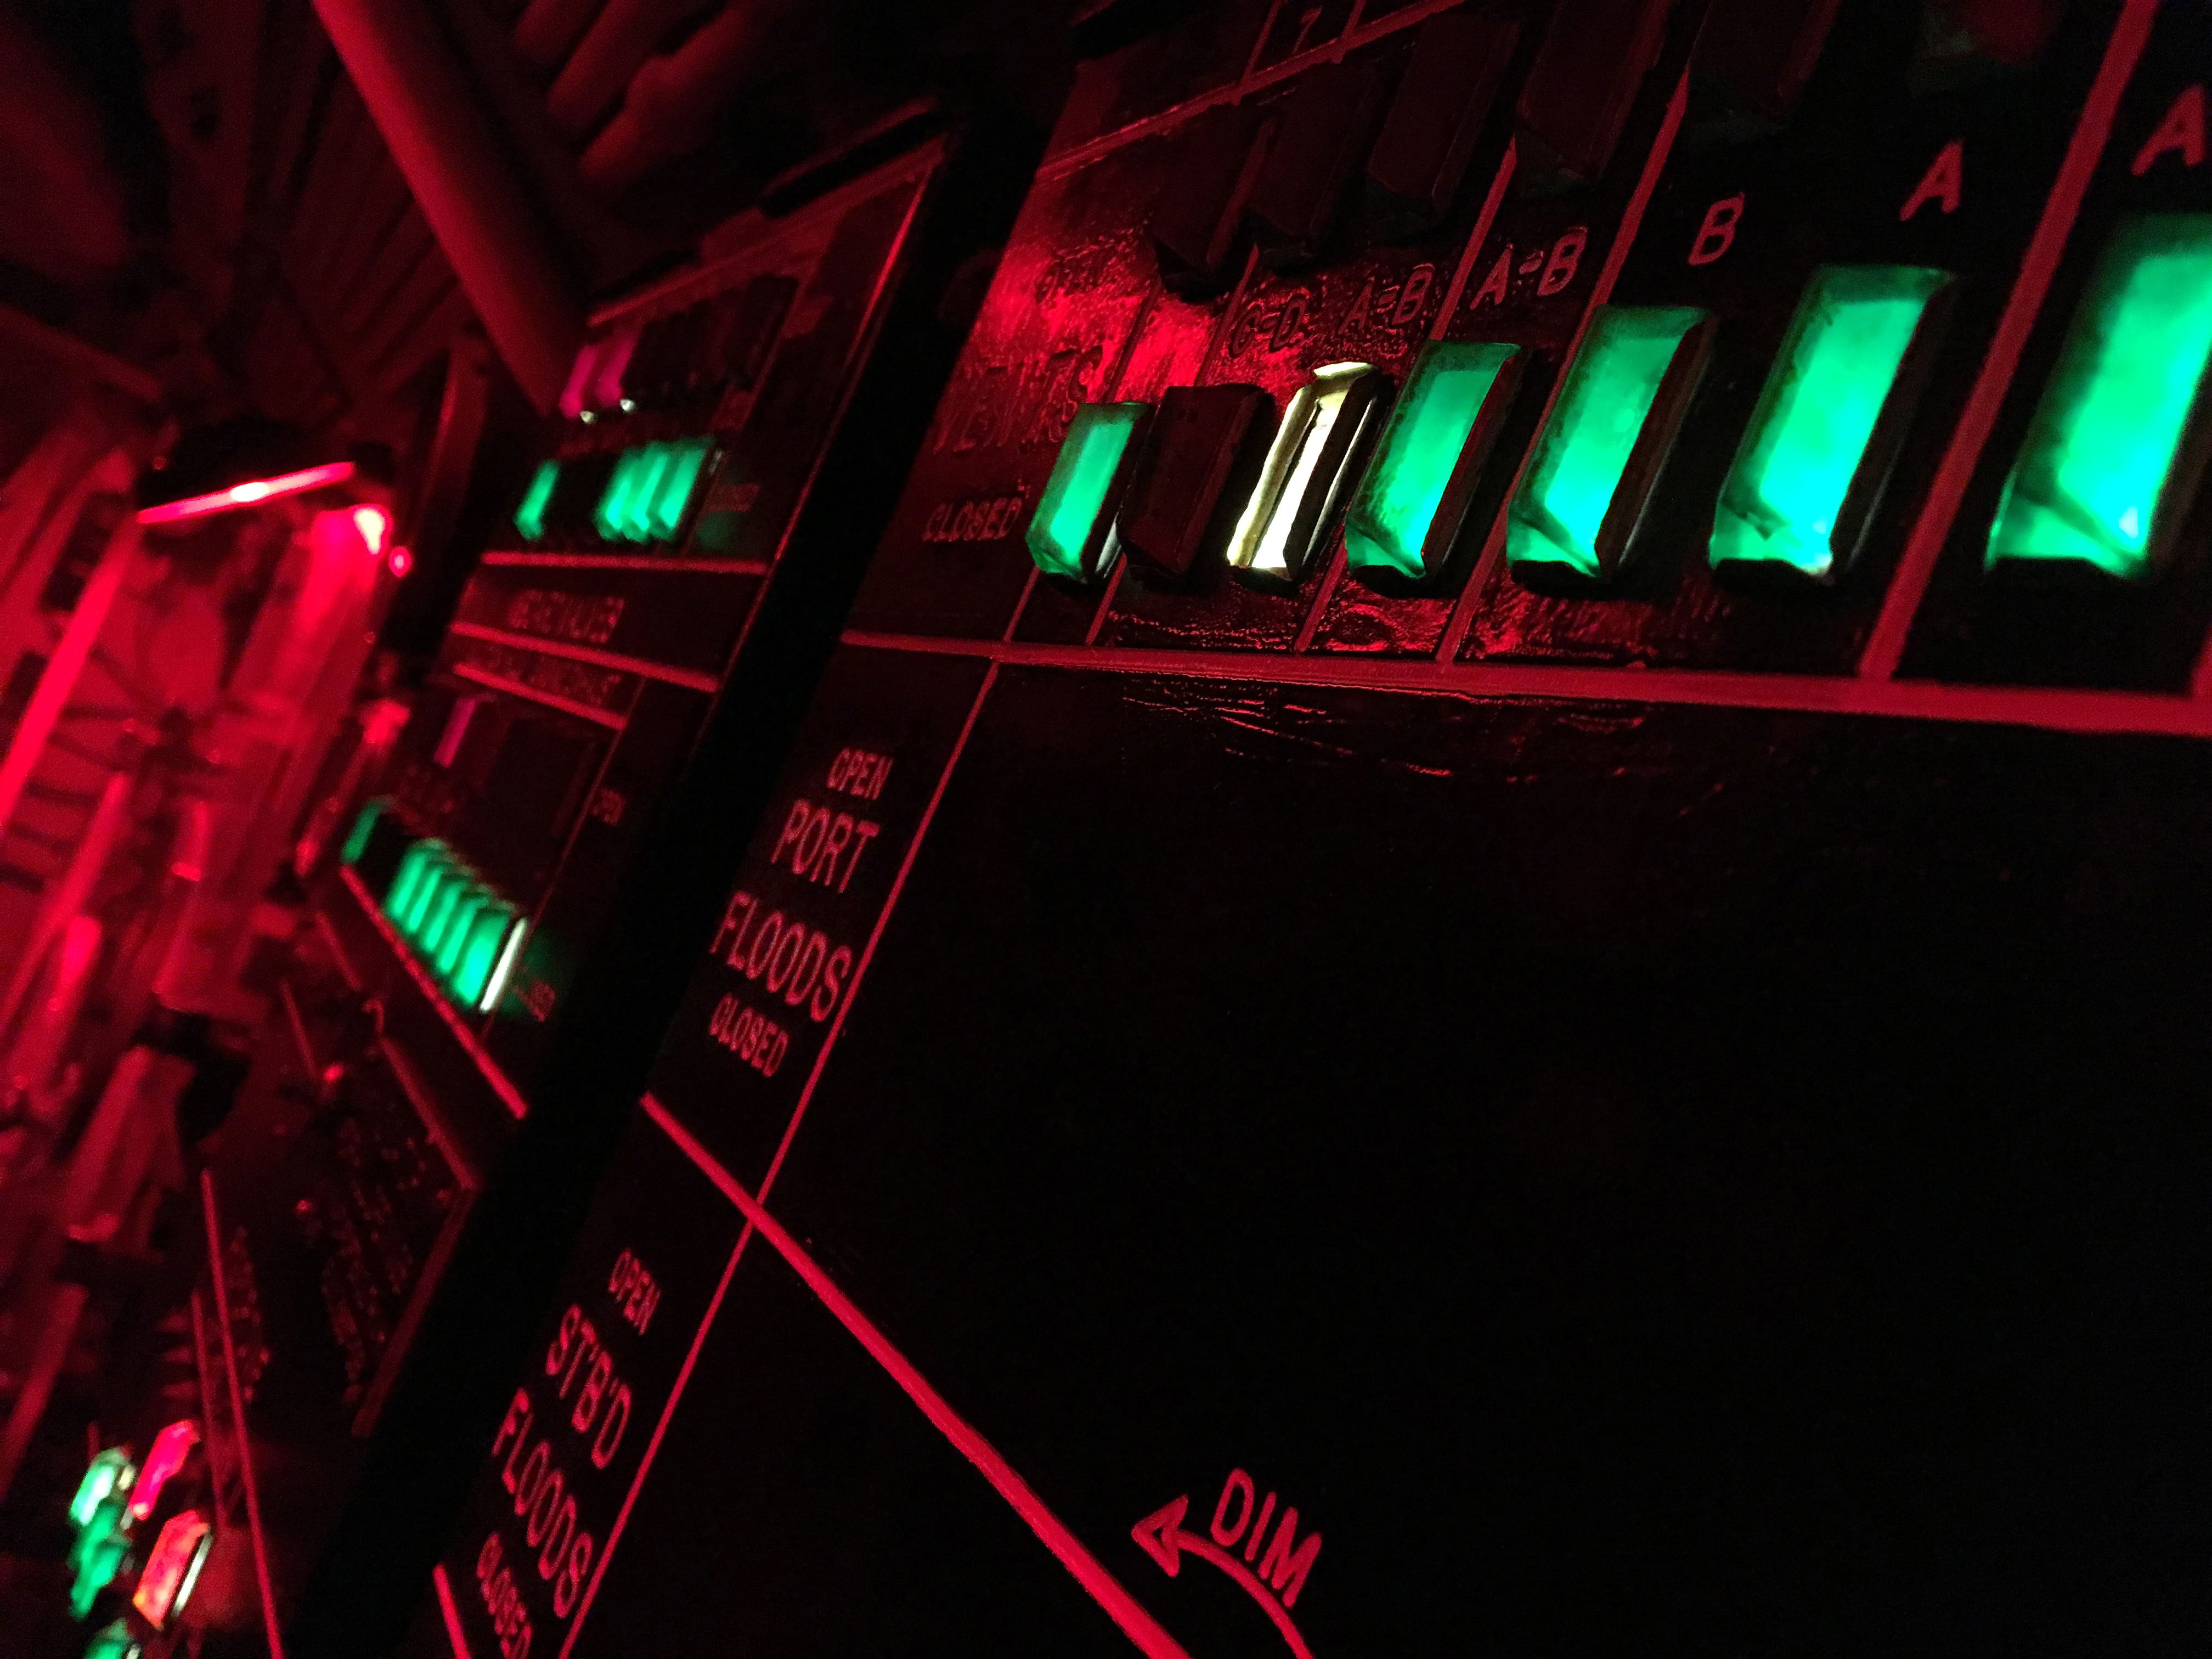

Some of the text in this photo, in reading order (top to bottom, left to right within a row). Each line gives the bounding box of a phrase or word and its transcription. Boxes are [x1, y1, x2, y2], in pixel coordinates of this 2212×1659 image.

[2130, 81, 2206, 178] A
[1897, 138, 1965, 221] A
[1686, 192, 1746, 266] B
[922, 497, 1024, 543] CLOSED
[826, 747, 894, 801] OPEN
[770, 798, 881, 894] PORT
[709, 889, 852, 1022] FLOODS
[708, 992, 789, 1079] CLOSED
[608, 1246, 662, 1336] OPEN
[492, 1387, 592, 1620] FLOODS
[1209, 1466, 1324, 1609] DIM
[477, 1532, 533, 1659] CLOSED
